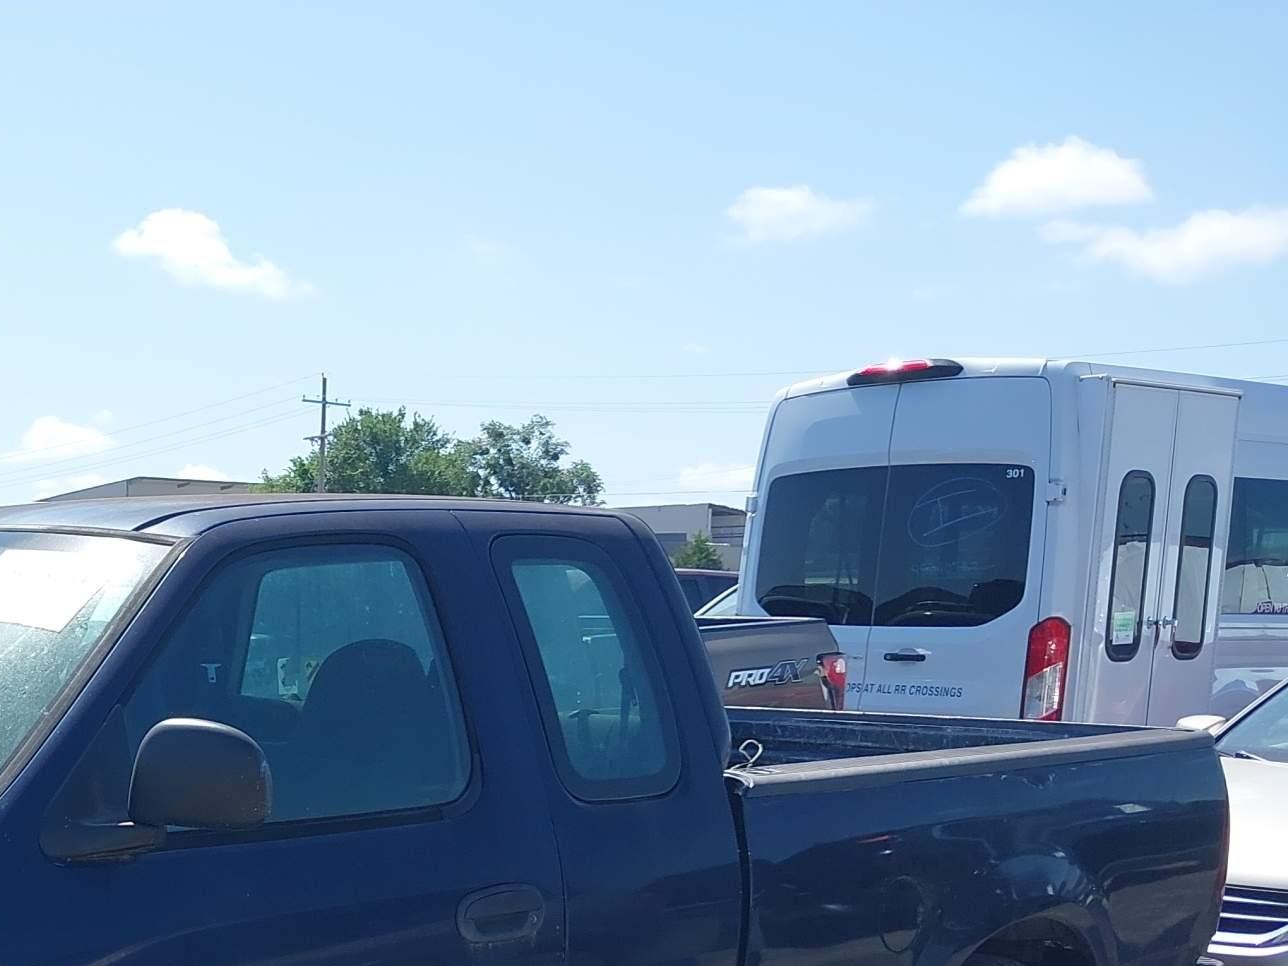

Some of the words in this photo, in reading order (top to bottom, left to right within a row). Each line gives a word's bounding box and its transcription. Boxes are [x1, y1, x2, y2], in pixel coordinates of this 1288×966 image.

[1006, 469, 1025, 479] 301
[862, 683, 875, 693] AT
[876, 684, 892, 695] ALL
[894, 684, 907, 695] RR
[908, 685, 964, 698] CROSSINGS
